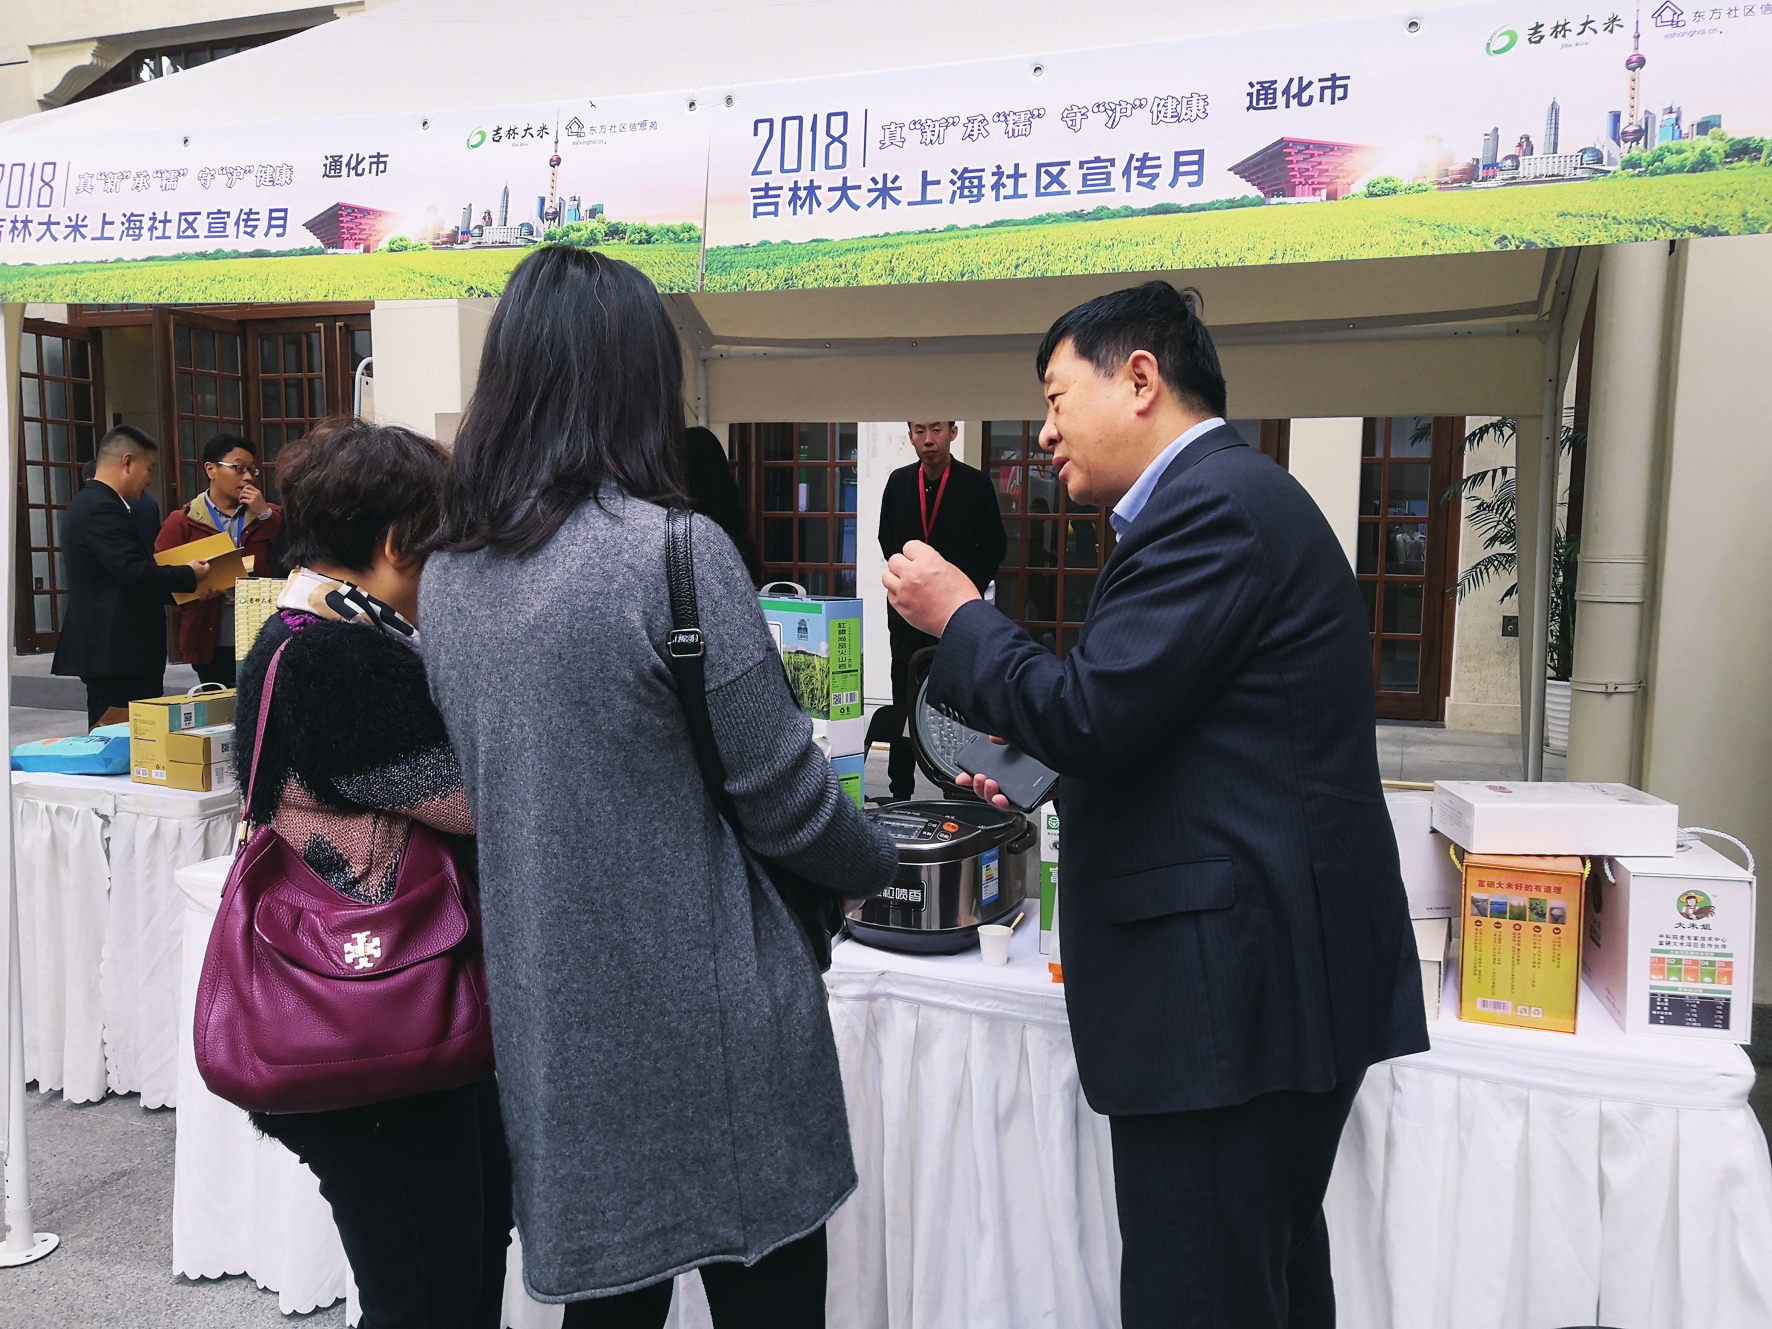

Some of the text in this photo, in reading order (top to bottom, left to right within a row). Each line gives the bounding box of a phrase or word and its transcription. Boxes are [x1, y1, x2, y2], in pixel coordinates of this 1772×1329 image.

[1527, 12, 1624, 44] 吉林大米
[1246, 72, 1351, 112] 通化市
[492, 122, 550, 143] 吉林大米
[751, 110, 849, 176] 2018
[322, 151, 390, 179] 通化市
[750, 148, 1206, 219] 吉林大米上海社区宣传月
[1477, 879, 1563, 895] 富硒大米好的有道理
[1674, 922, 1712, 931] 大米姐
